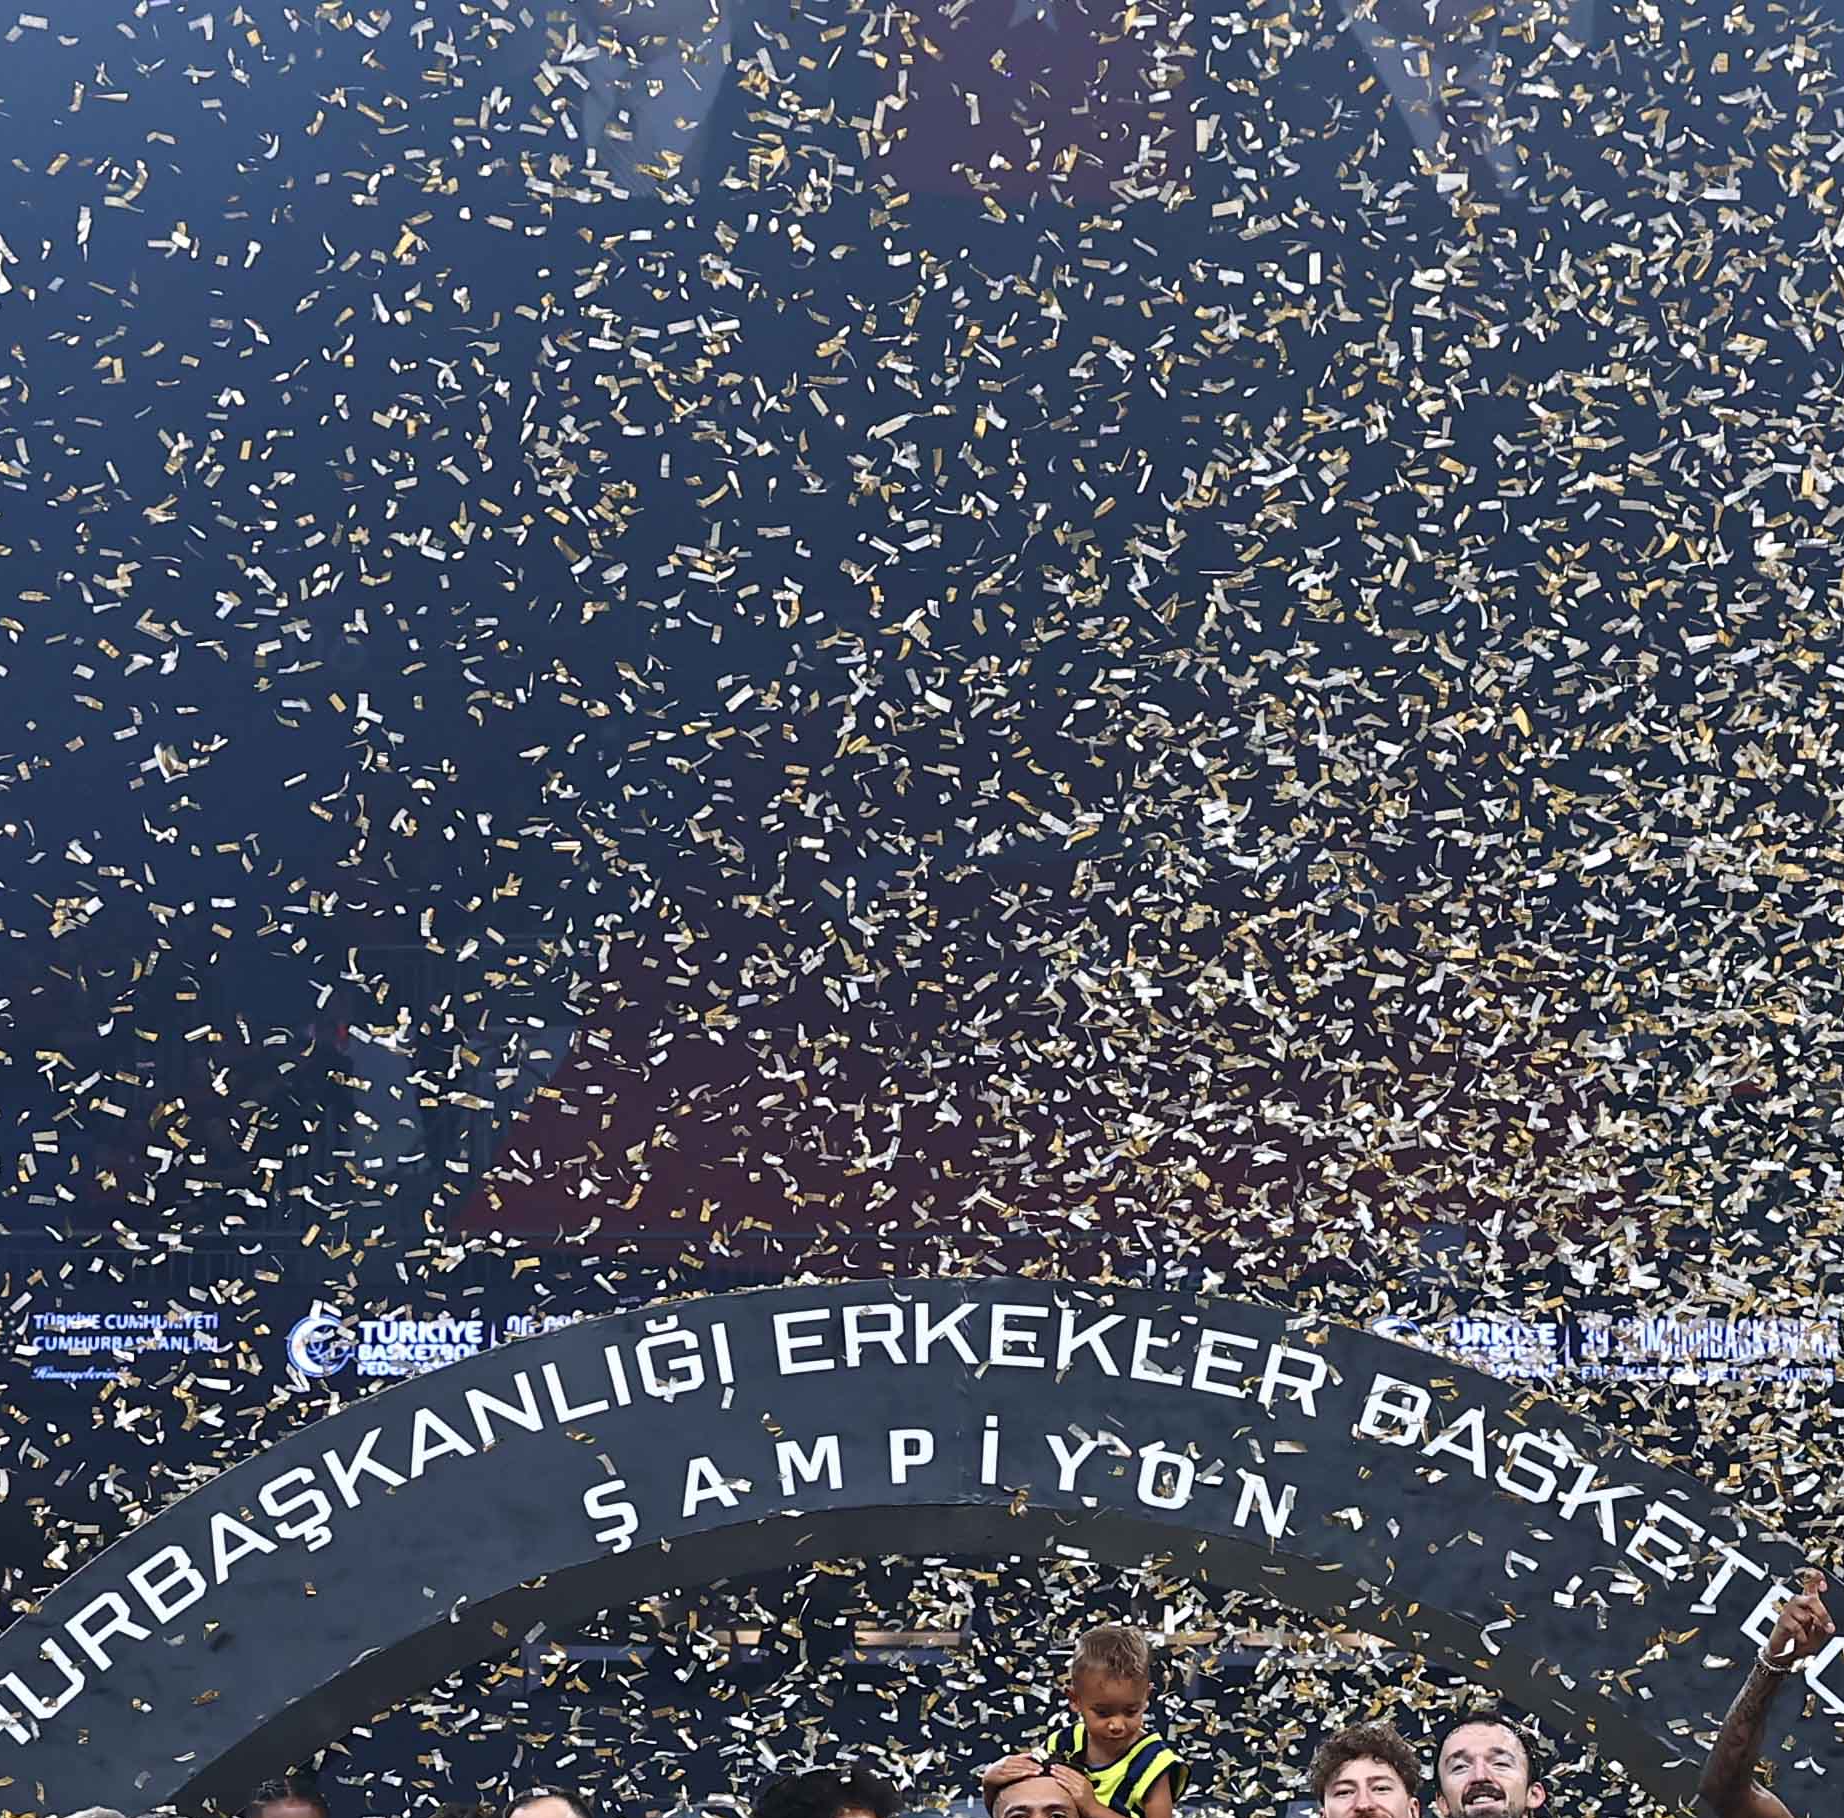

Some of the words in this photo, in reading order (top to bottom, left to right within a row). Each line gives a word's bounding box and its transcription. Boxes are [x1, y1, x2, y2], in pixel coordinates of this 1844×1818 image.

[358, 1319, 483, 1343] TÜRKİYE
[773, 1302, 1328, 1417] ERKEKLER
[584, 1415, 1299, 1555] ŞAMPİYON
